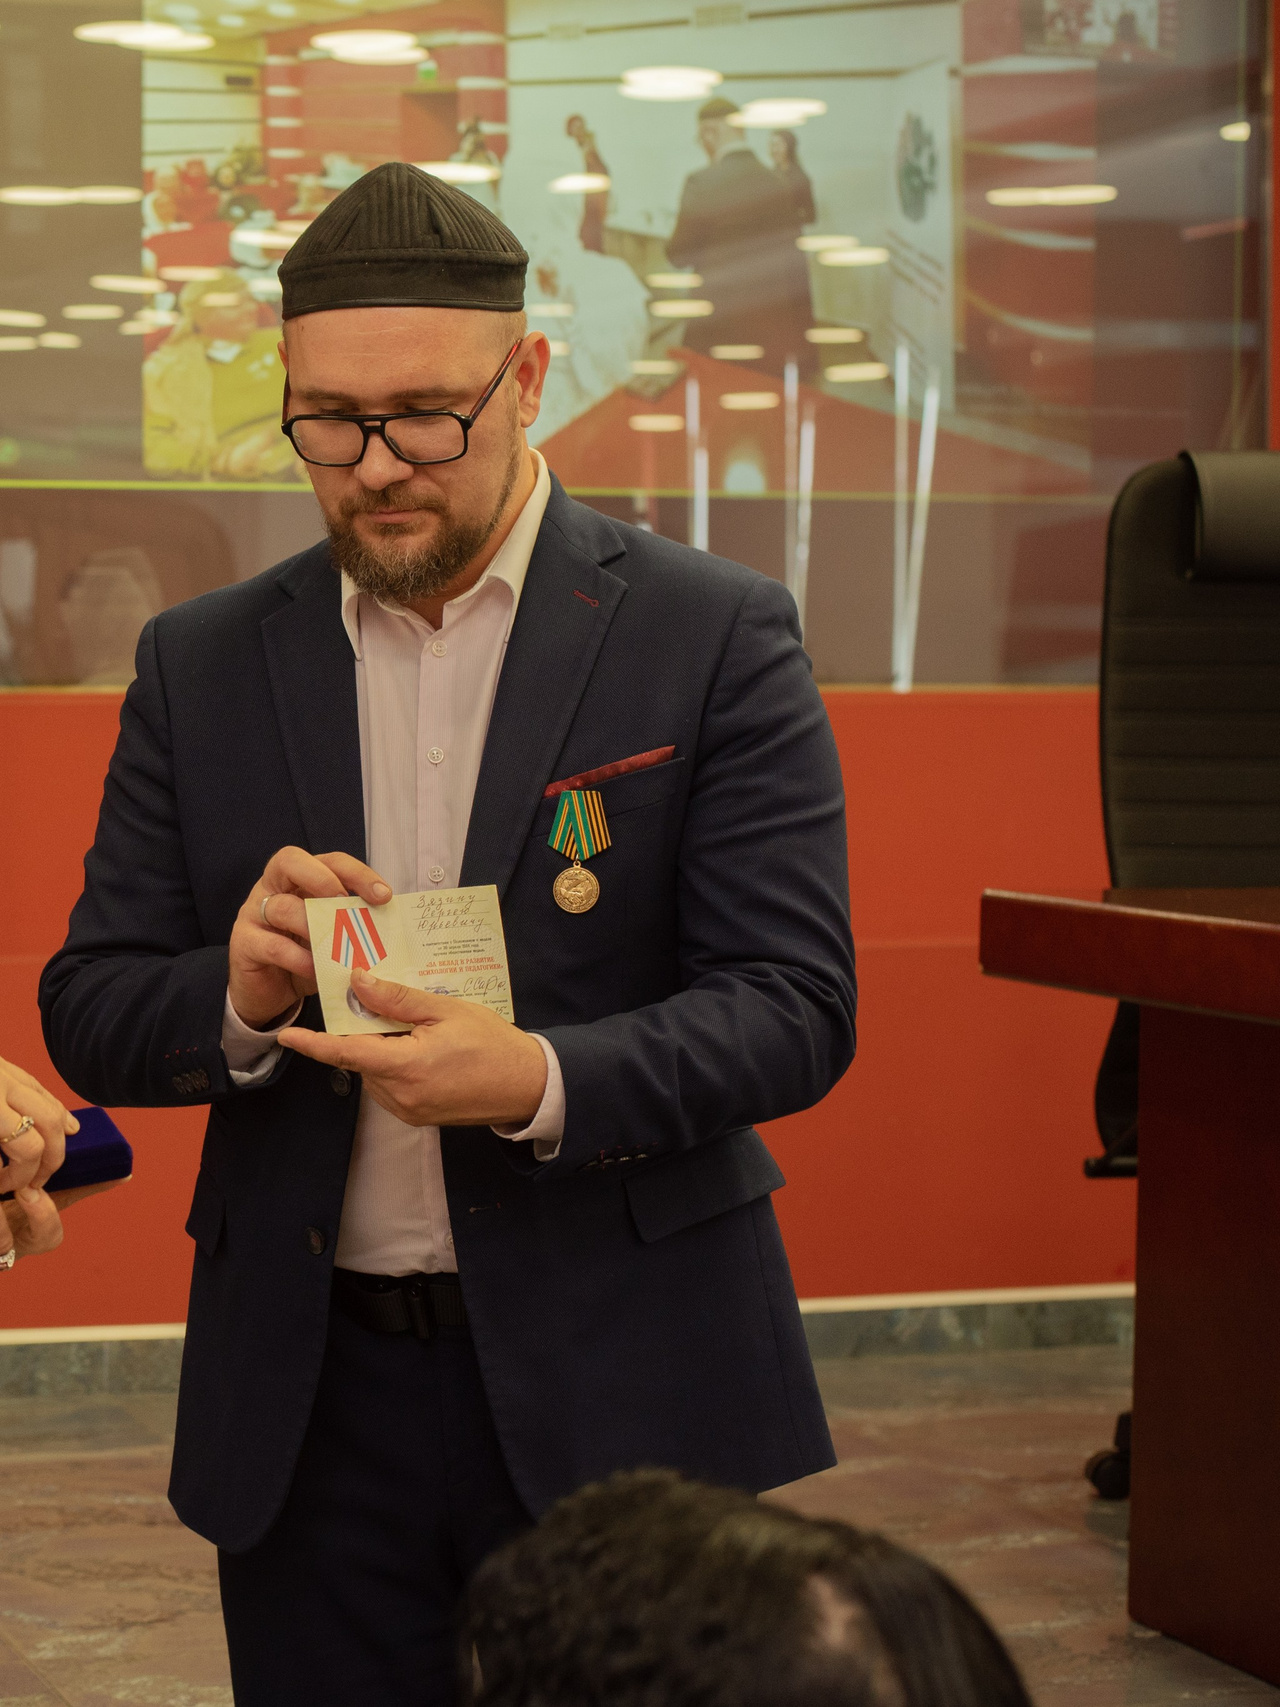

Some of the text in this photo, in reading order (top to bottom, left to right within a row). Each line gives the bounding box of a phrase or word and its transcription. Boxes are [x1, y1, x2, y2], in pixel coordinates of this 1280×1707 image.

[421, 907, 470, 922] Сергею
[417, 916, 484, 935] Юрьевичу
[466, 956, 495, 965] РАЗВИТИЕ
[418, 967, 458, 977] ПСИХОЛОГИИ
